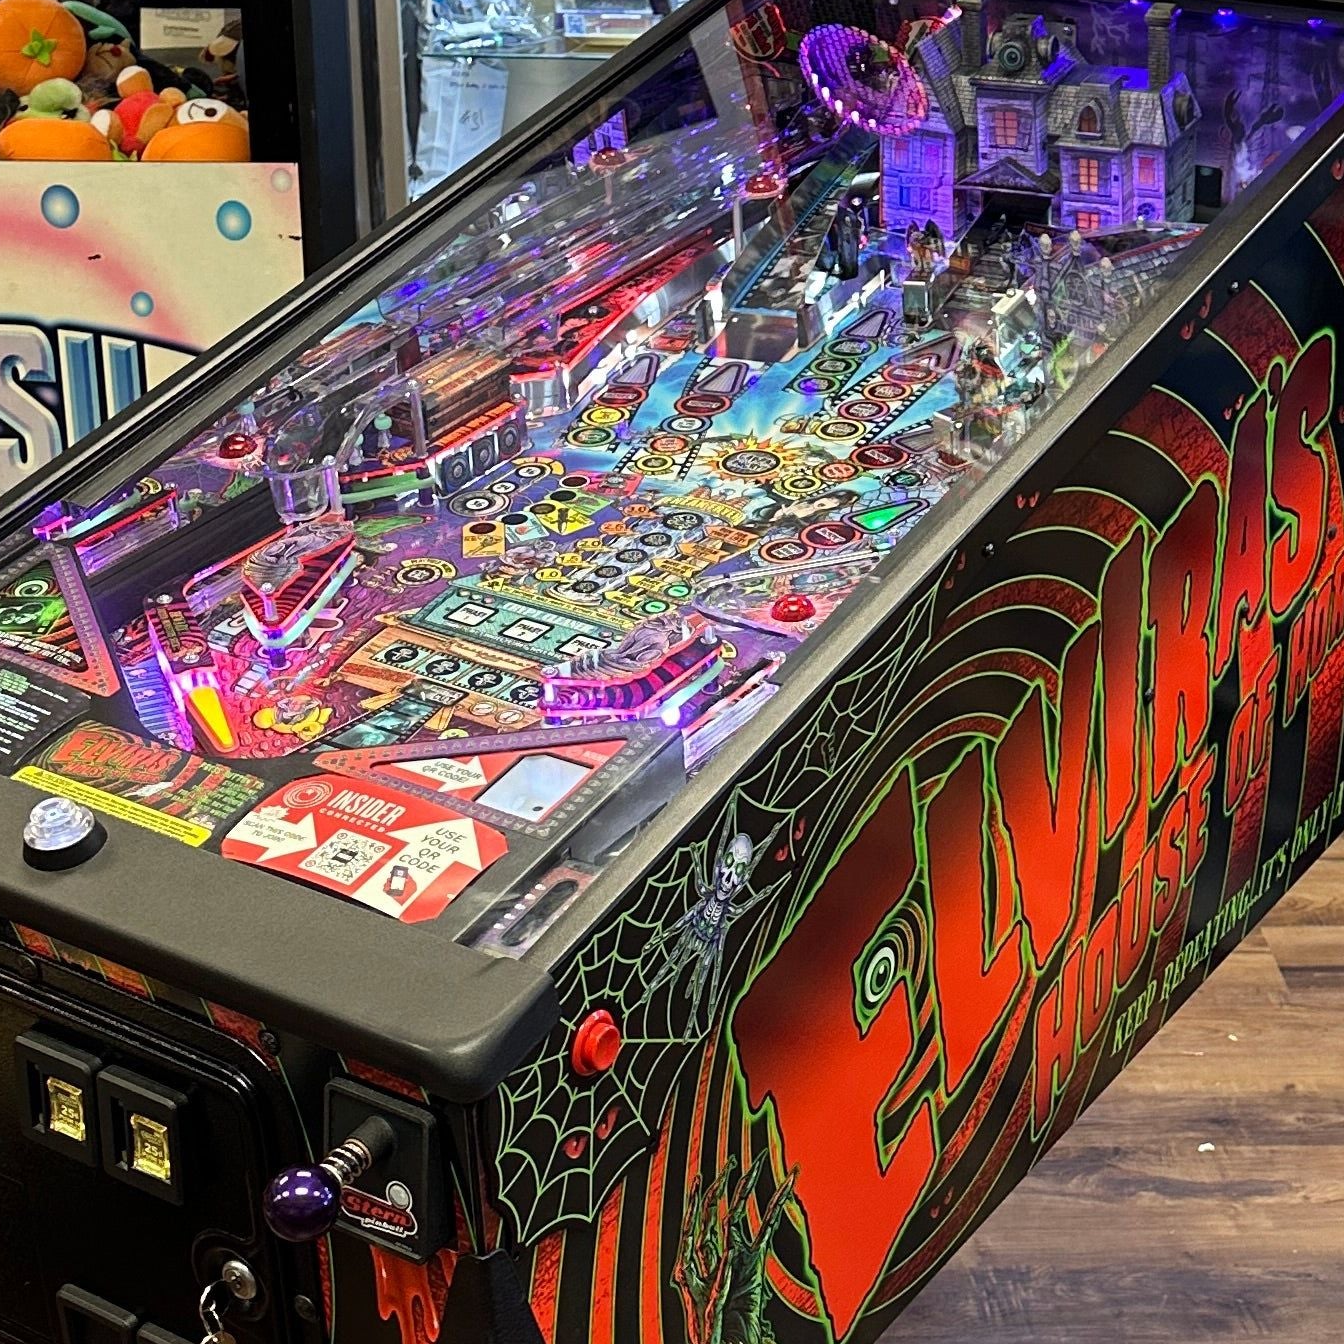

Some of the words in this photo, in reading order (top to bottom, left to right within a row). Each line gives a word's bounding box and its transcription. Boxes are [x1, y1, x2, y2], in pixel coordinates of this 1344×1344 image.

[578, 540, 600, 548] 2.0
[538, 570, 559, 578] 1.0
[422, 765, 437, 774] QR
[438, 769, 469, 784] CODE!
[435, 761, 456, 771] USE
[456, 767, 483, 780] YOUR
[327, 789, 406, 827] INSIDER
[243, 820, 265, 829] SCAN
[318, 807, 388, 834] CONNECTED
[435, 827, 468, 843] USE
[418, 847, 442, 860] QR
[419, 834, 461, 856] YOUR
[398, 854, 442, 875] CODE
[1030, 746, 1218, 1146] HOUSE
[1224, 644, 1283, 816] OF
[1110, 979, 1158, 1058] KEEP
[1290, 798, 1330, 863] ONLY
[346, 1195, 408, 1226] Stern
[364, 1217, 404, 1233] pinball
